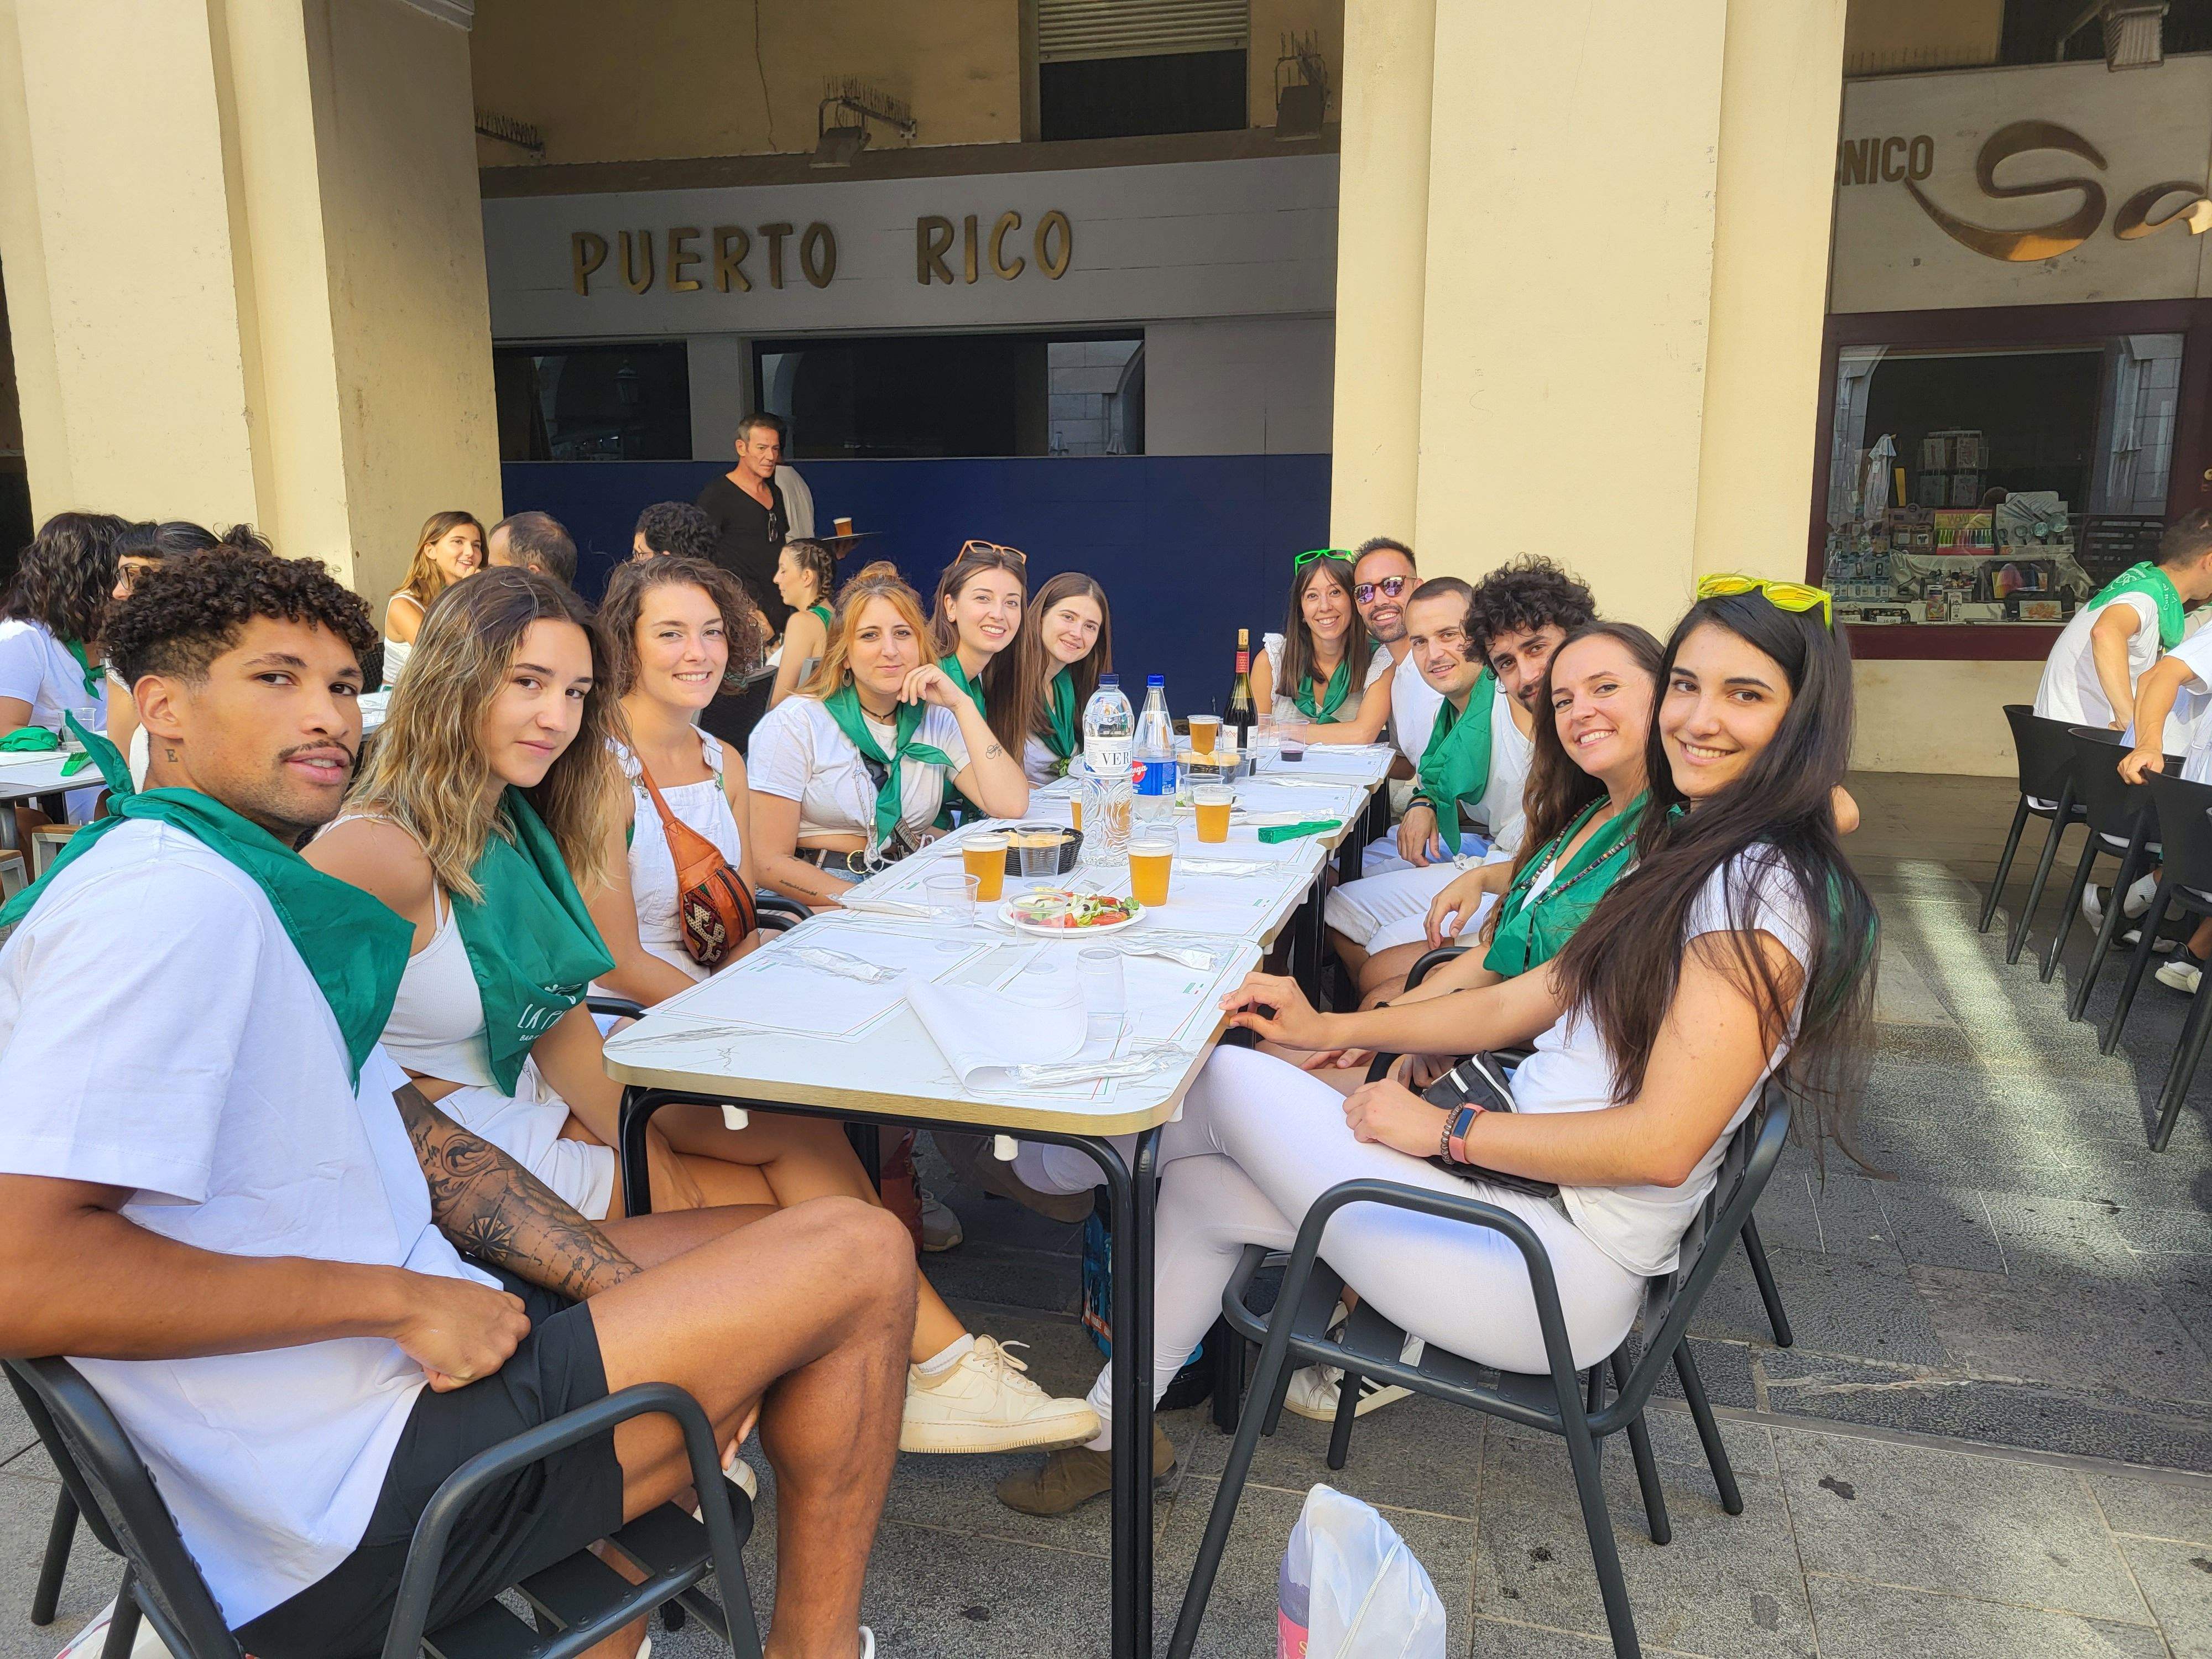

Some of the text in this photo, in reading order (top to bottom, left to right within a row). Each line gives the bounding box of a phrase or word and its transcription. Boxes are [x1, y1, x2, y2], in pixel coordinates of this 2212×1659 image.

[1835, 135, 1934, 186] NICO
[571, 210, 1073, 296] PUERTO RICO
[165, 749, 178, 762] E
[518, 1004, 547, 1029] LA
